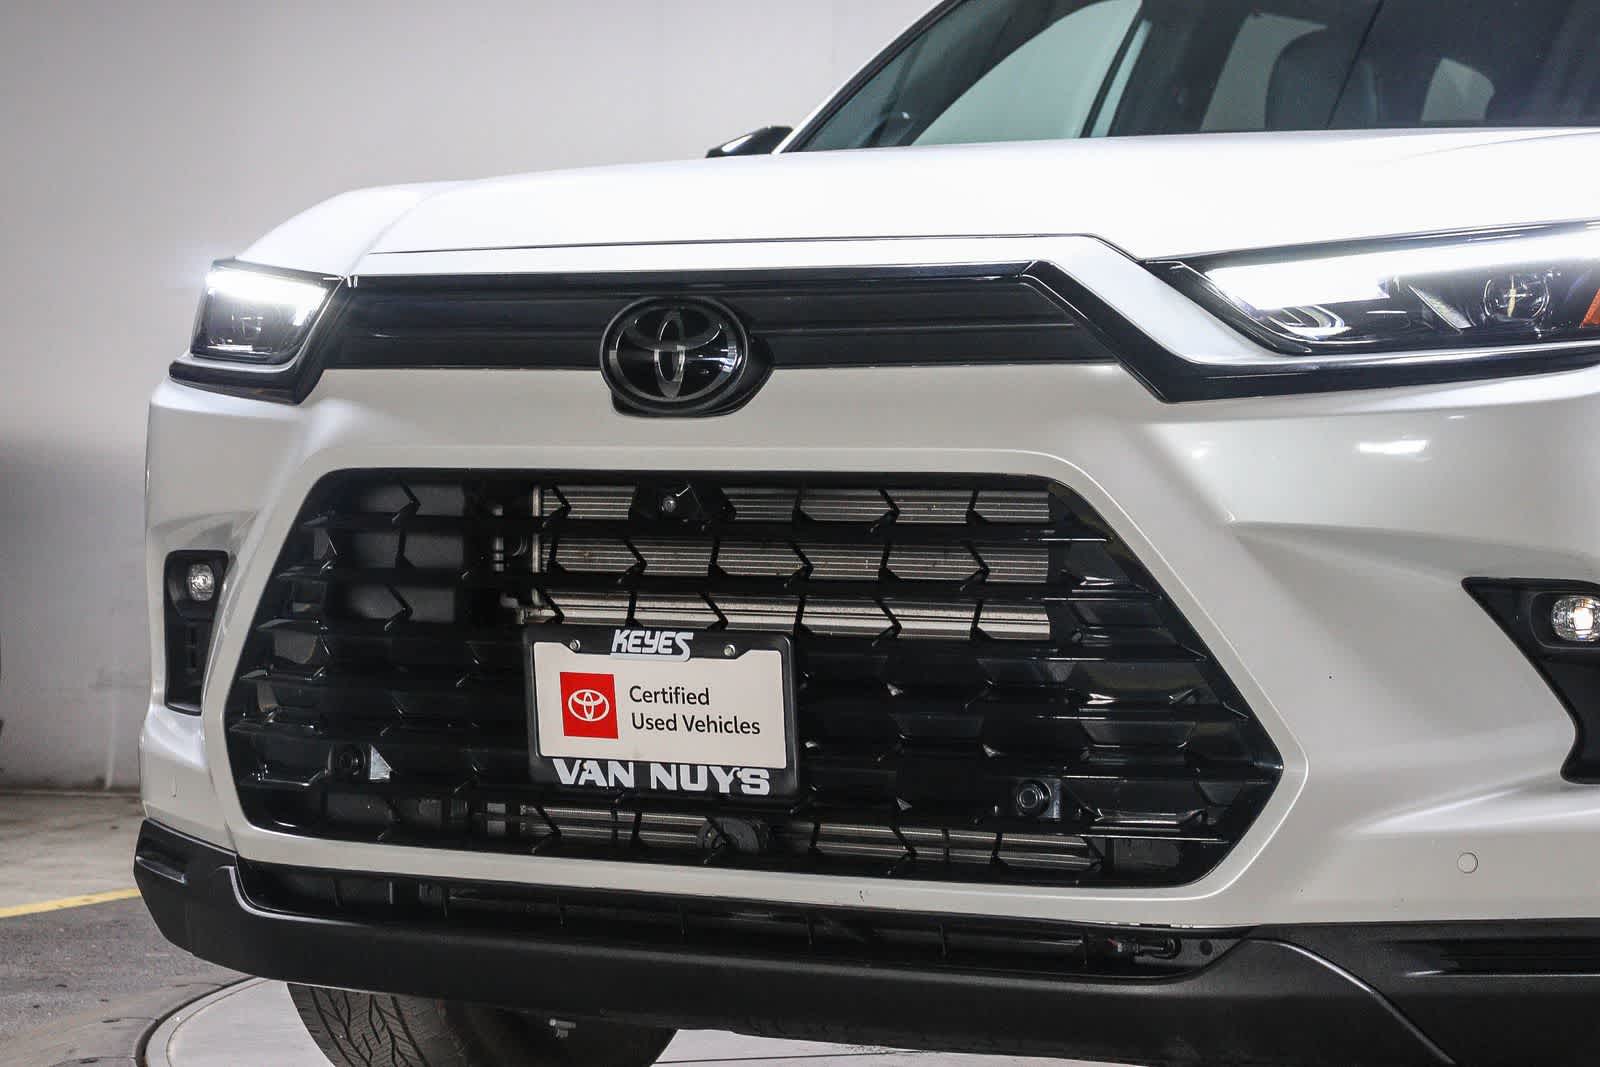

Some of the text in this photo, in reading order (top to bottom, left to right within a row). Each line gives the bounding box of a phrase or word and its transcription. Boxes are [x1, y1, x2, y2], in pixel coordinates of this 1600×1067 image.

[610, 629, 694, 661] KEYES
[629, 685, 710, 706] Certified
[631, 712, 761, 734] Used Vehicles
[552, 758, 770, 795] VAN NUYS
